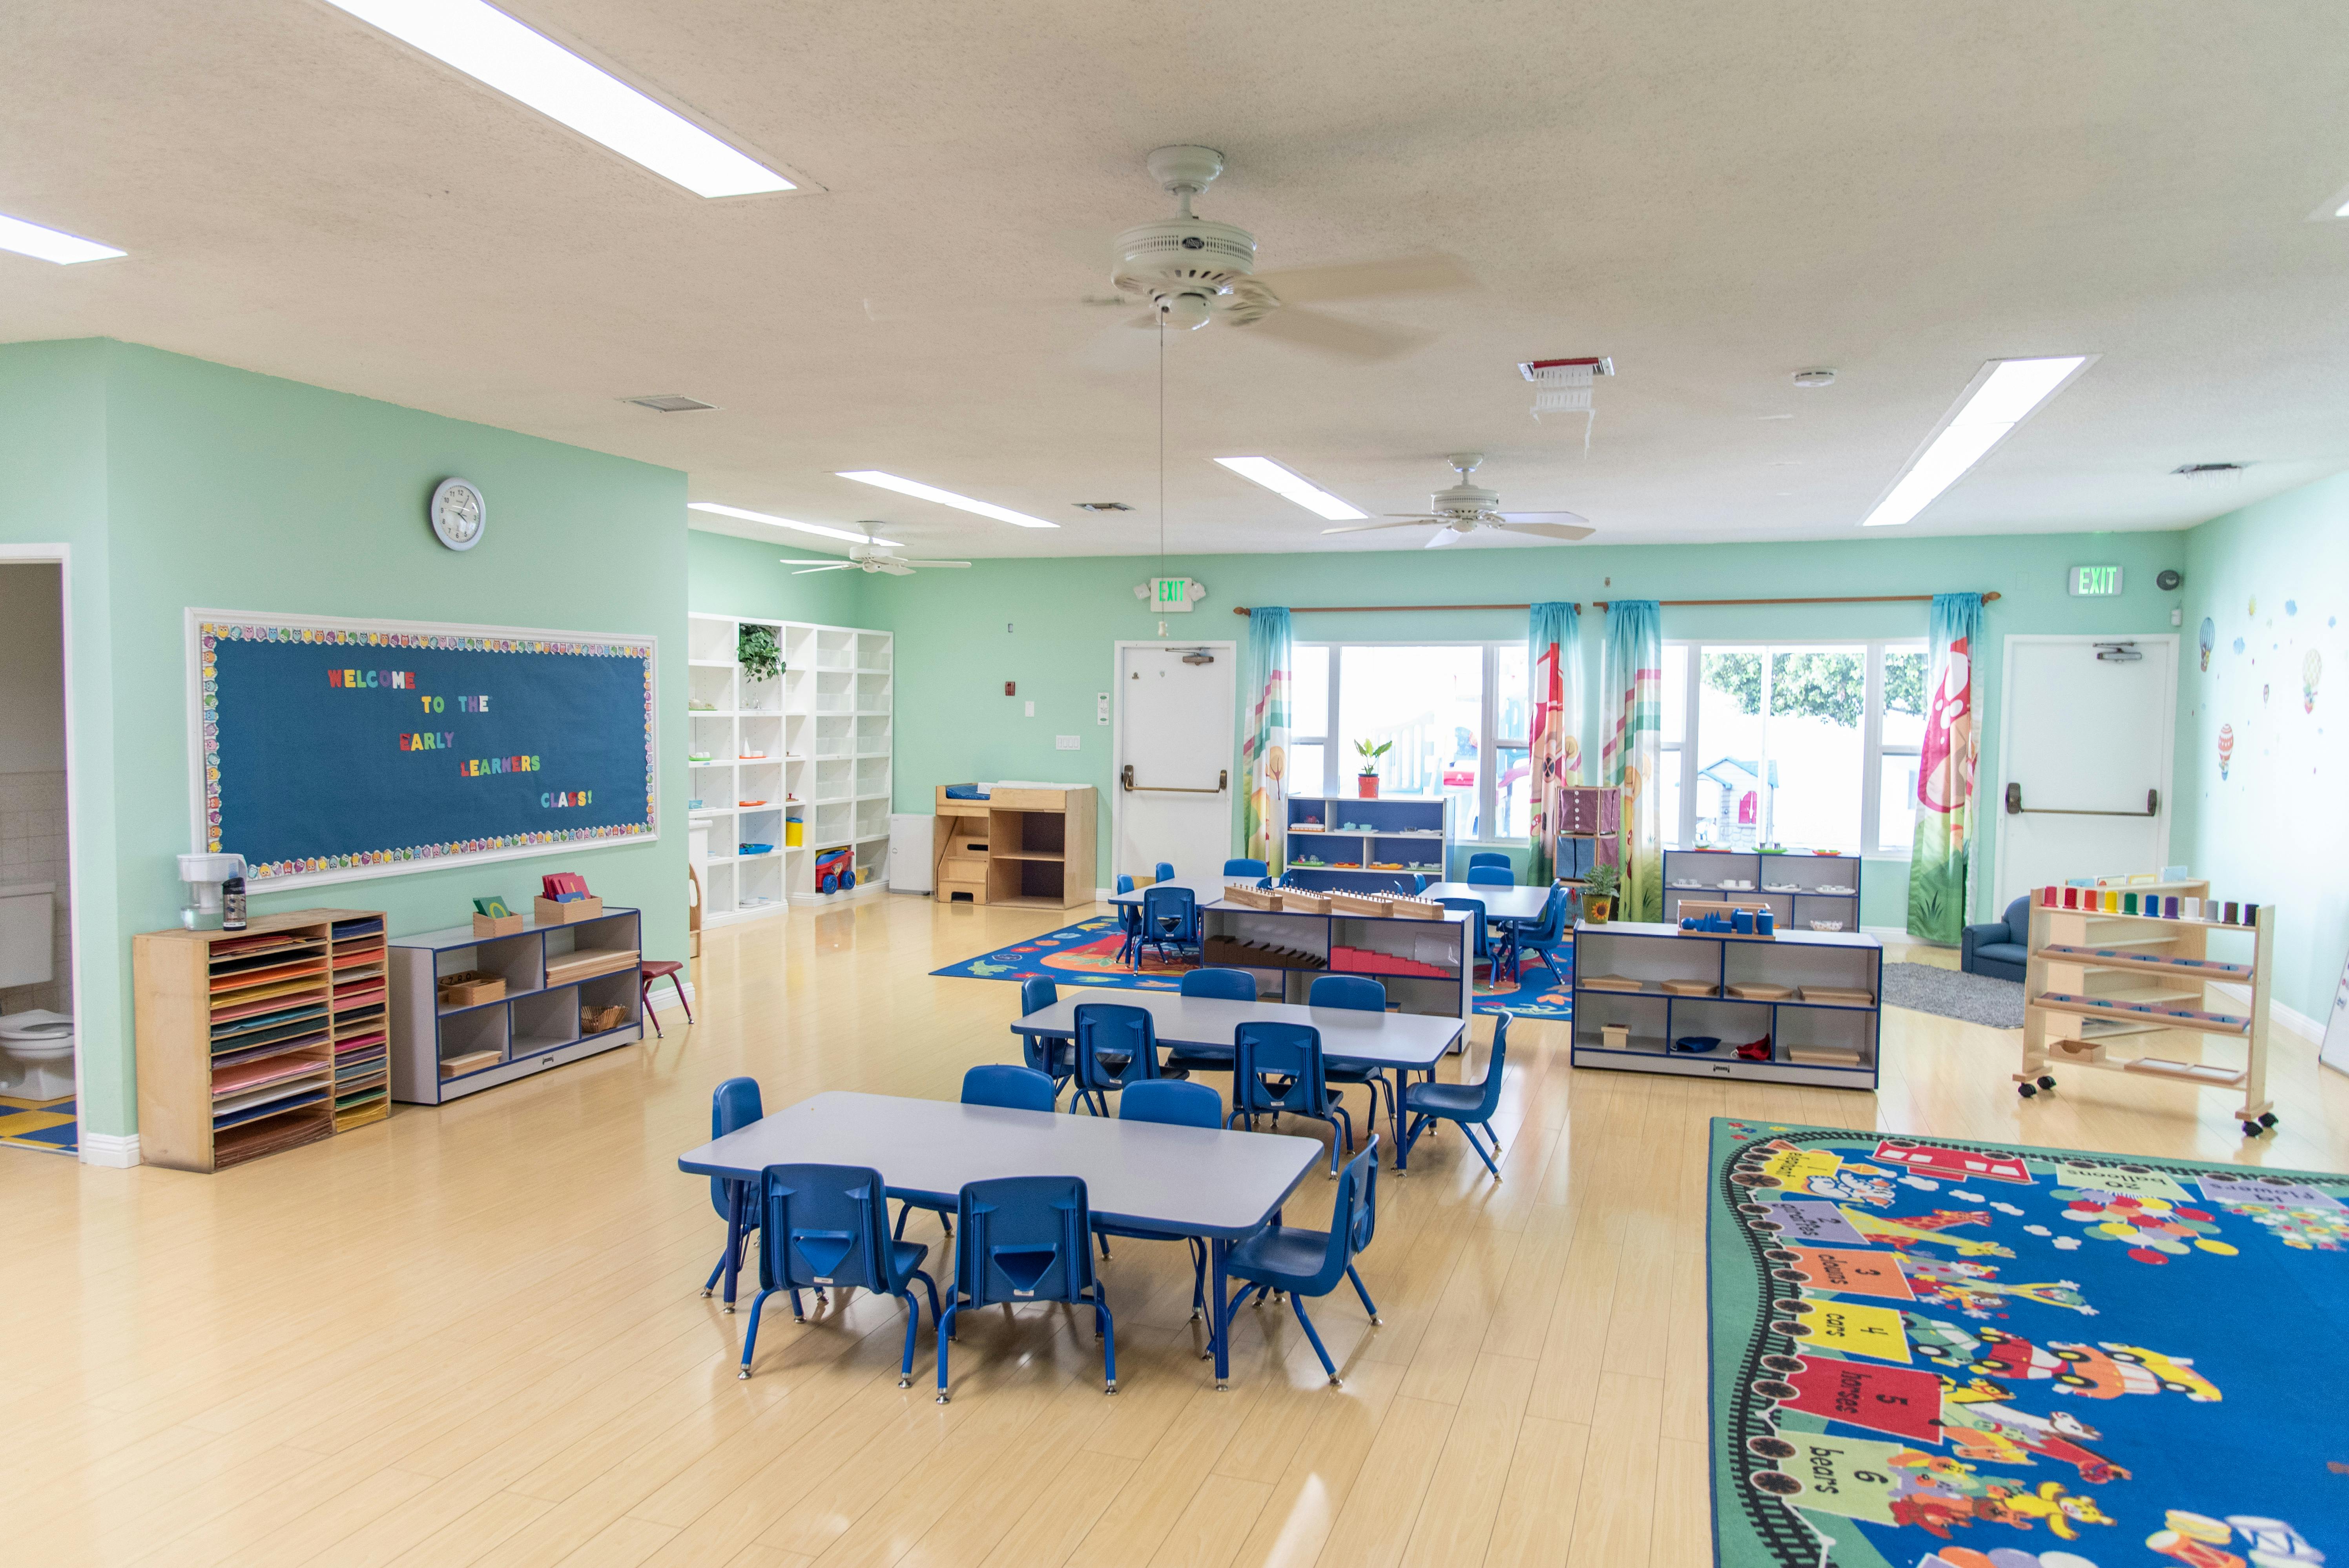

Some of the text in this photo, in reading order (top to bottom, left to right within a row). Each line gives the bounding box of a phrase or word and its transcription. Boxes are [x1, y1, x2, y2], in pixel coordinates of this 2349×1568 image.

[2079, 567, 2117, 594] EXIT
[1159, 581, 1185, 602] EXIT
[328, 669, 416, 689] WELCOME
[421, 695, 489, 713] TO THE
[400, 731, 454, 751] EARLY
[461, 755, 540, 777] LEARNERS
[541, 790, 592, 808] CLASS!
[2066, 1169, 2167, 1185] balloons
[2105, 1180, 2140, 1190] 20
[1771, 1203, 1821, 1236] giraffes
[1818, 1254, 1849, 1284] clowns
[1826, 1313, 1845, 1337] cars
[1860, 1326, 1888, 1335] 4
[1835, 1370, 1872, 1414] horses
[1876, 1394, 1908, 1406] 5
[1809, 1446, 1844, 1495] bears
[1853, 1470, 1889, 1484] 6
